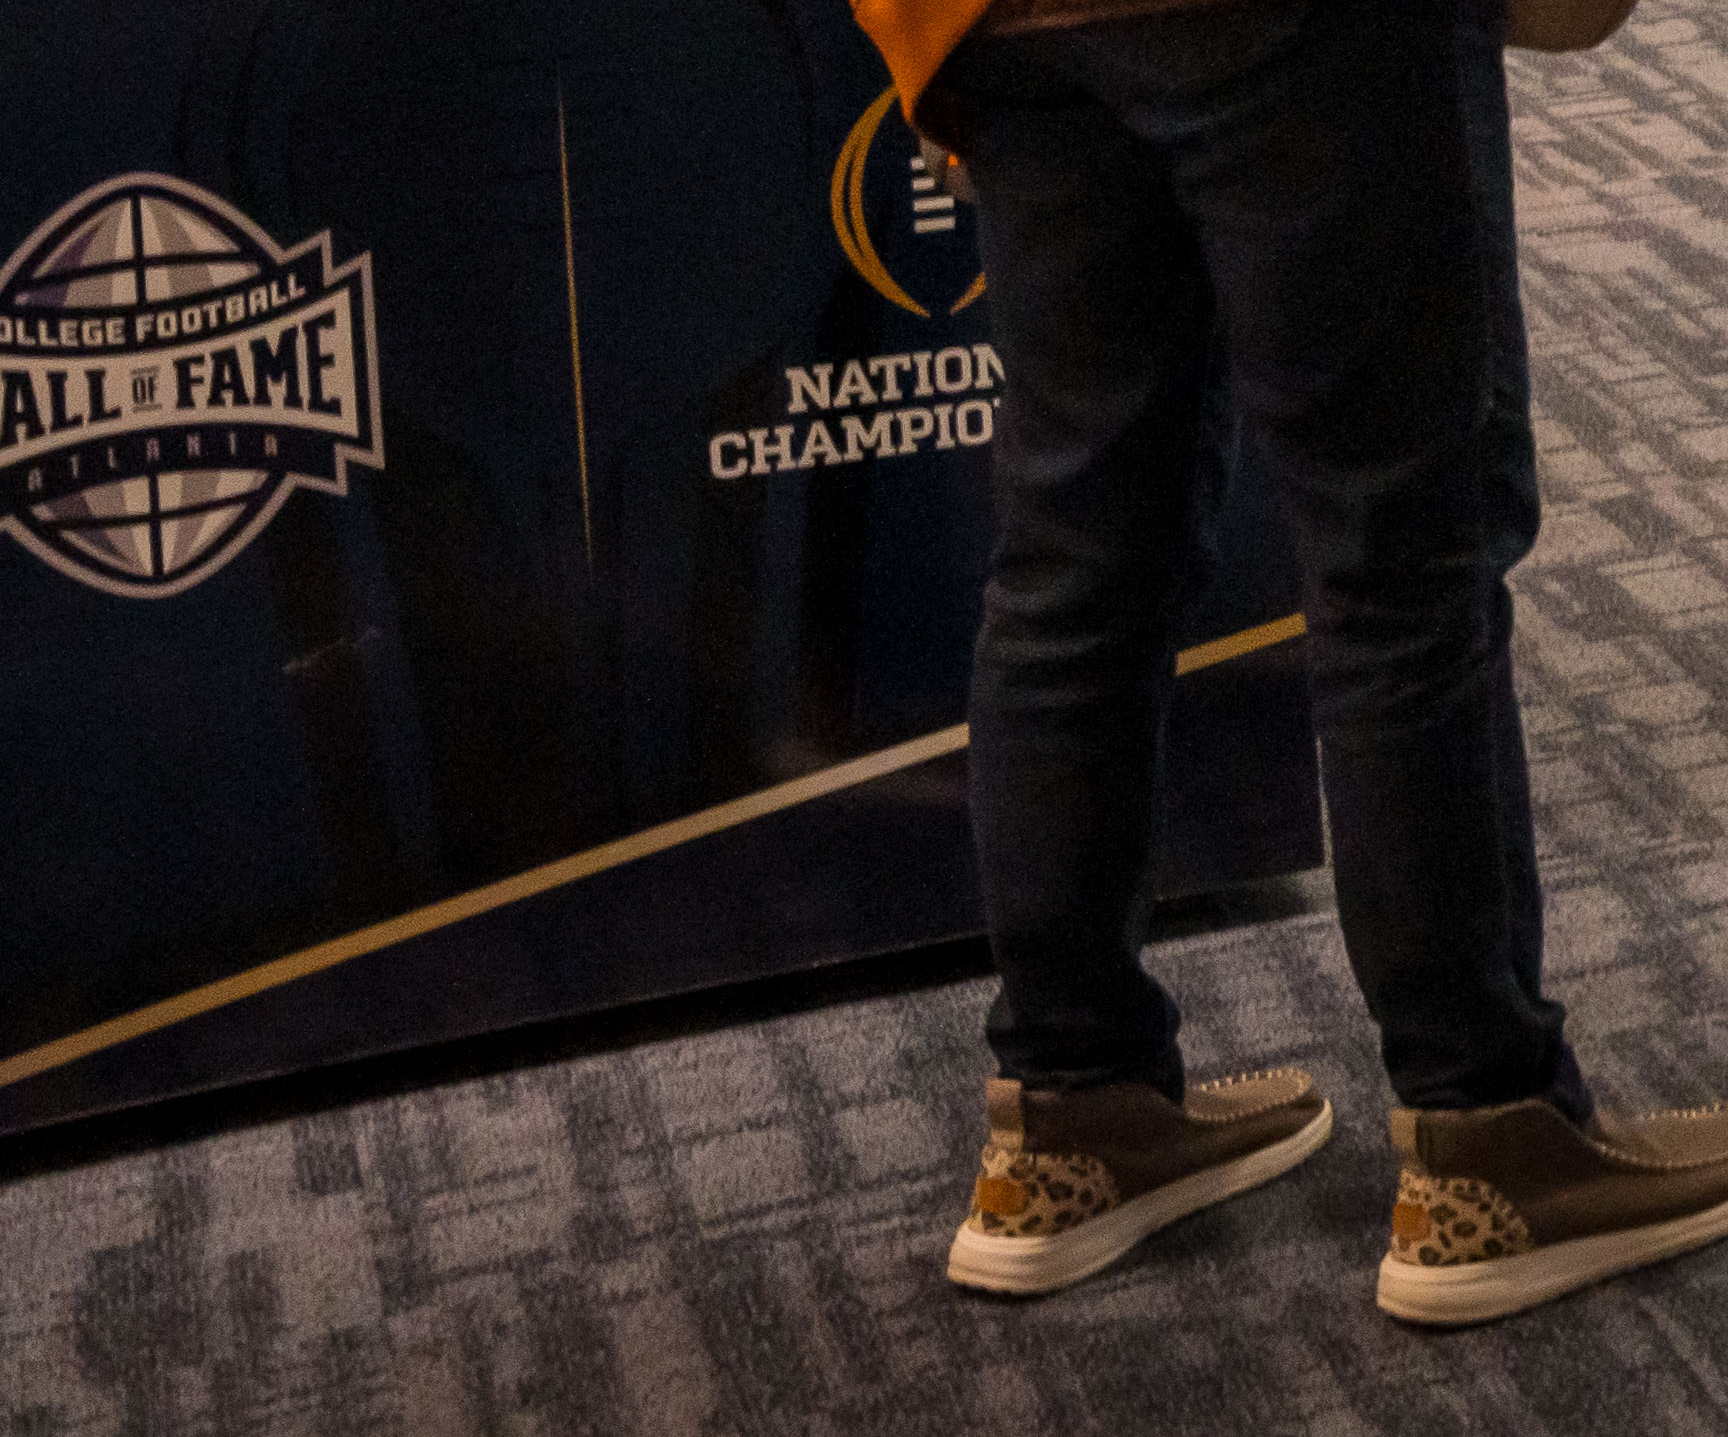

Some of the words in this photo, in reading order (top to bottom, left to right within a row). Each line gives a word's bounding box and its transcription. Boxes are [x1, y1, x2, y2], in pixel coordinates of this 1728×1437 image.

[0, 317, 126, 348] OLLEGE
[136, 272, 307, 344] FOOTBALL
[0, 367, 122, 447] ALL
[131, 376, 160, 405] OF
[173, 308, 343, 418] FAME
[784, 343, 1007, 415] NATION
[27, 431, 279, 493] ATLANTA
[708, 396, 1001, 480] CHAMPIO
